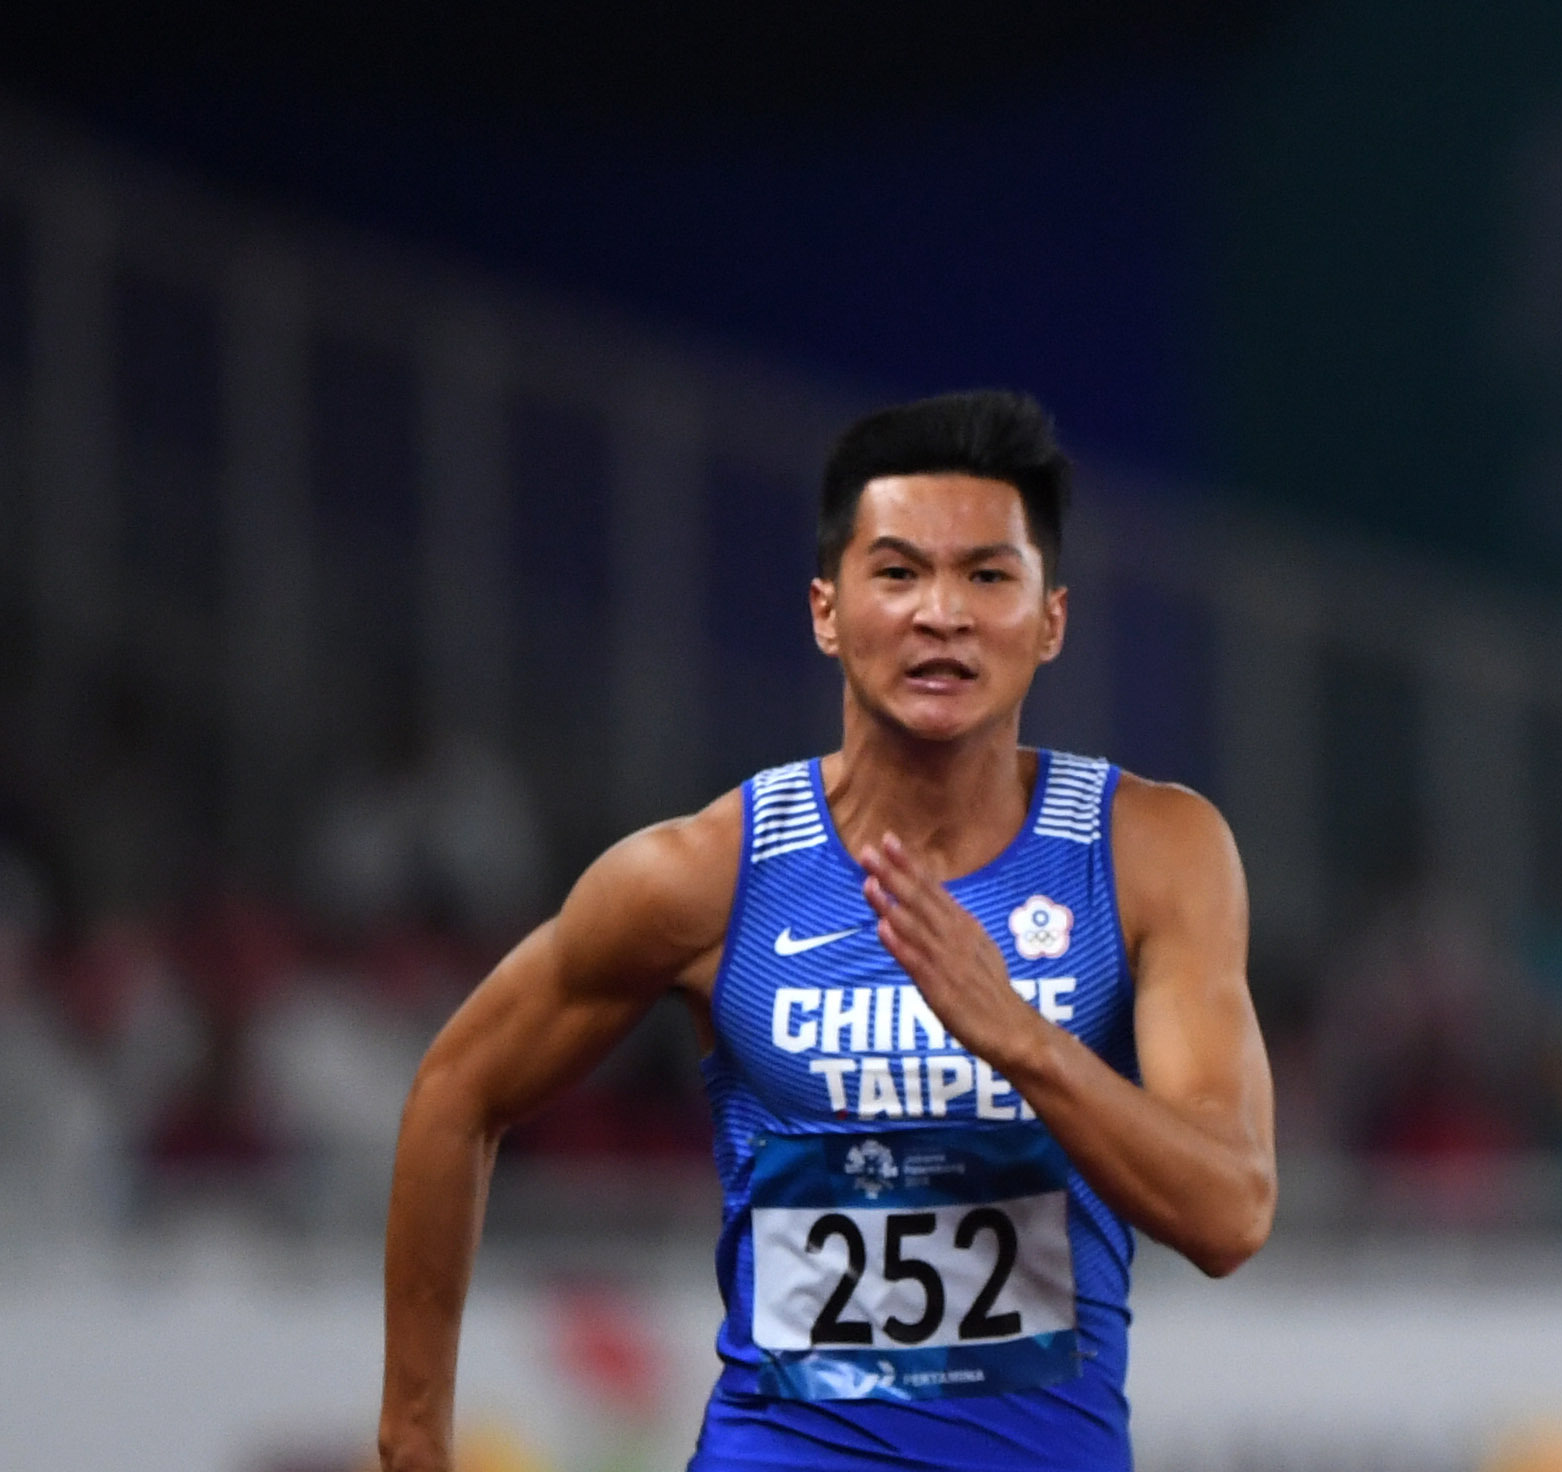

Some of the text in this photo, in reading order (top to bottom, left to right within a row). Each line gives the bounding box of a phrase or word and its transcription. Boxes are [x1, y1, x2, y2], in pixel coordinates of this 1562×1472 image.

[772, 977, 1077, 1053] CHINE
[809, 1056, 1037, 1120] TAIPE
[805, 1207, 1022, 1345] 252
